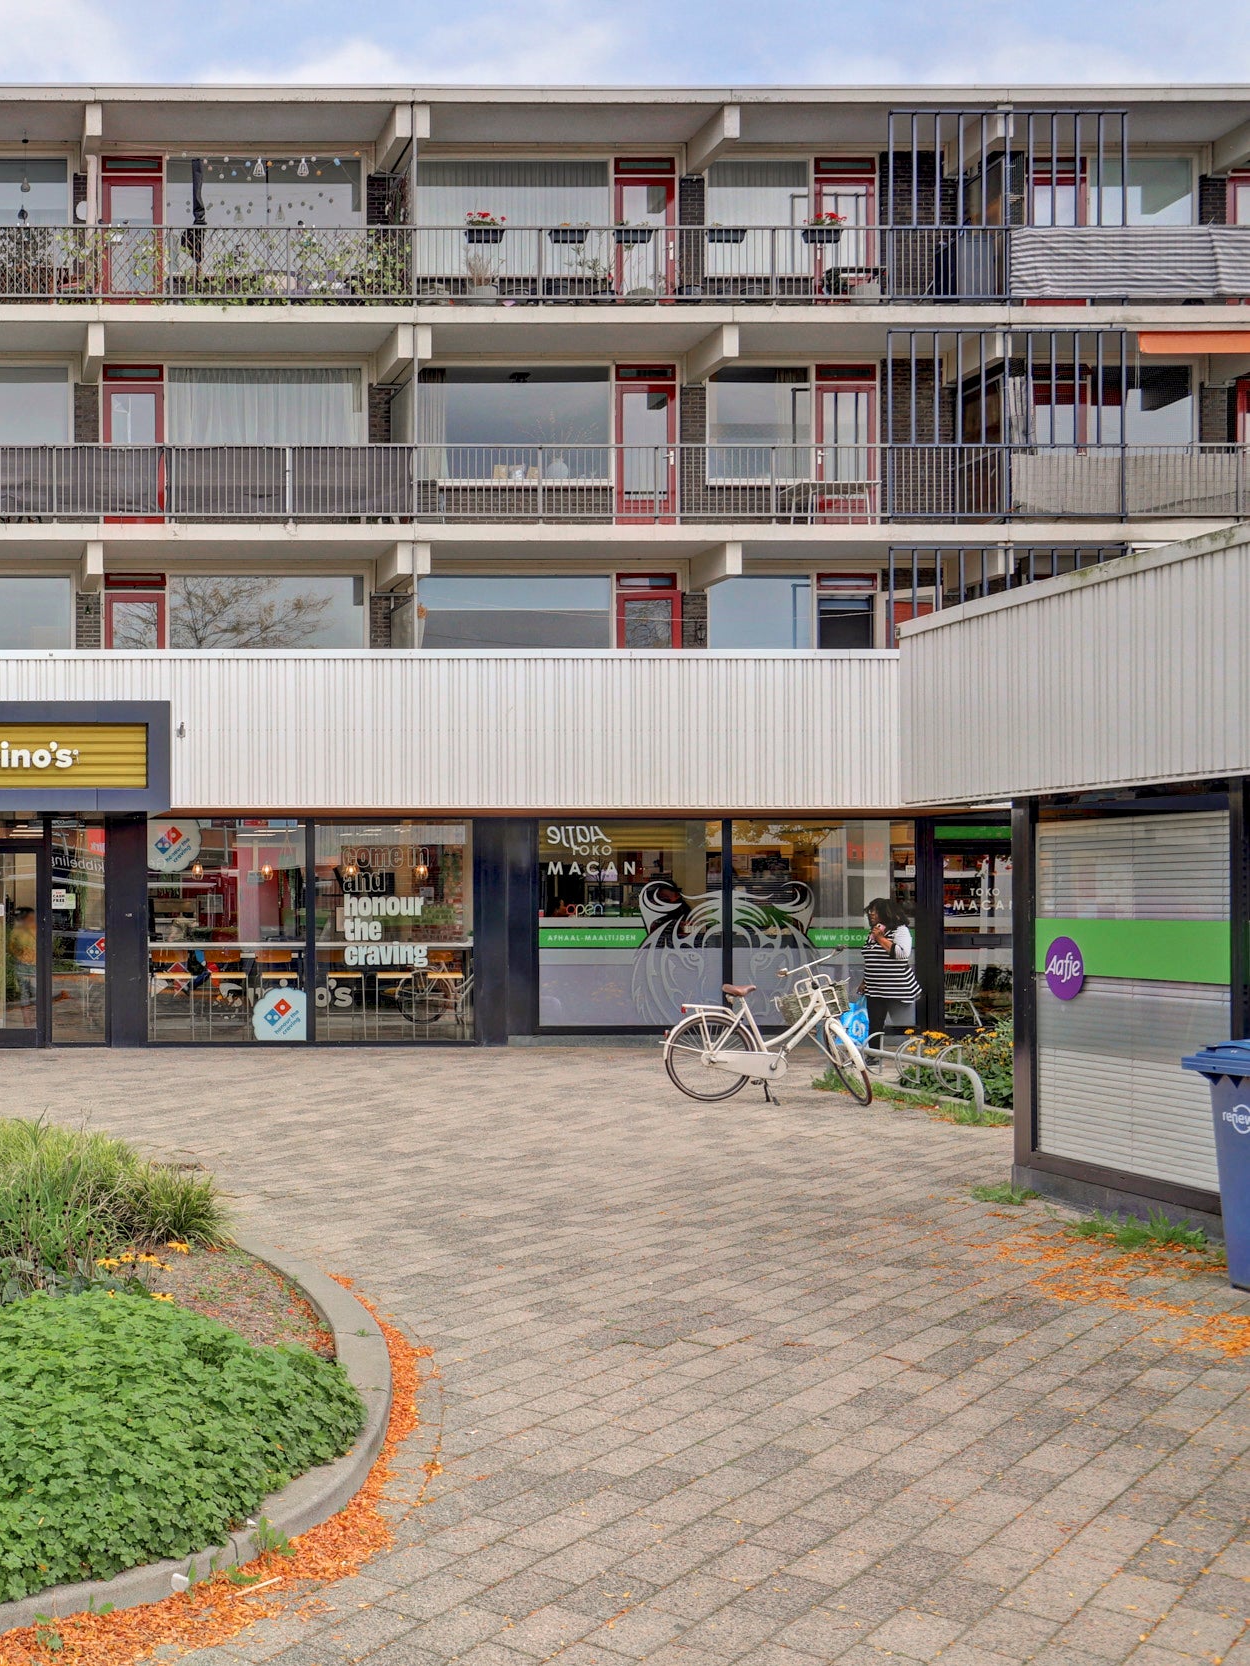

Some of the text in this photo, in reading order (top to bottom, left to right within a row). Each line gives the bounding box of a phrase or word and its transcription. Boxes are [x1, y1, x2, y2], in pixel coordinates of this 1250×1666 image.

[342, 843, 430, 868] come in
[343, 868, 386, 893] and
[547, 861, 636, 876] MACAN
[970, 887, 1000, 896] TOKO
[343, 893, 425, 917] honour
[565, 904, 603, 917] open
[343, 917, 383, 942] the
[547, 934, 637, 942] AFHAAL-MAALTIJDEN
[343, 940, 429, 968] craving
[1045, 952, 1081, 983] Aafje
